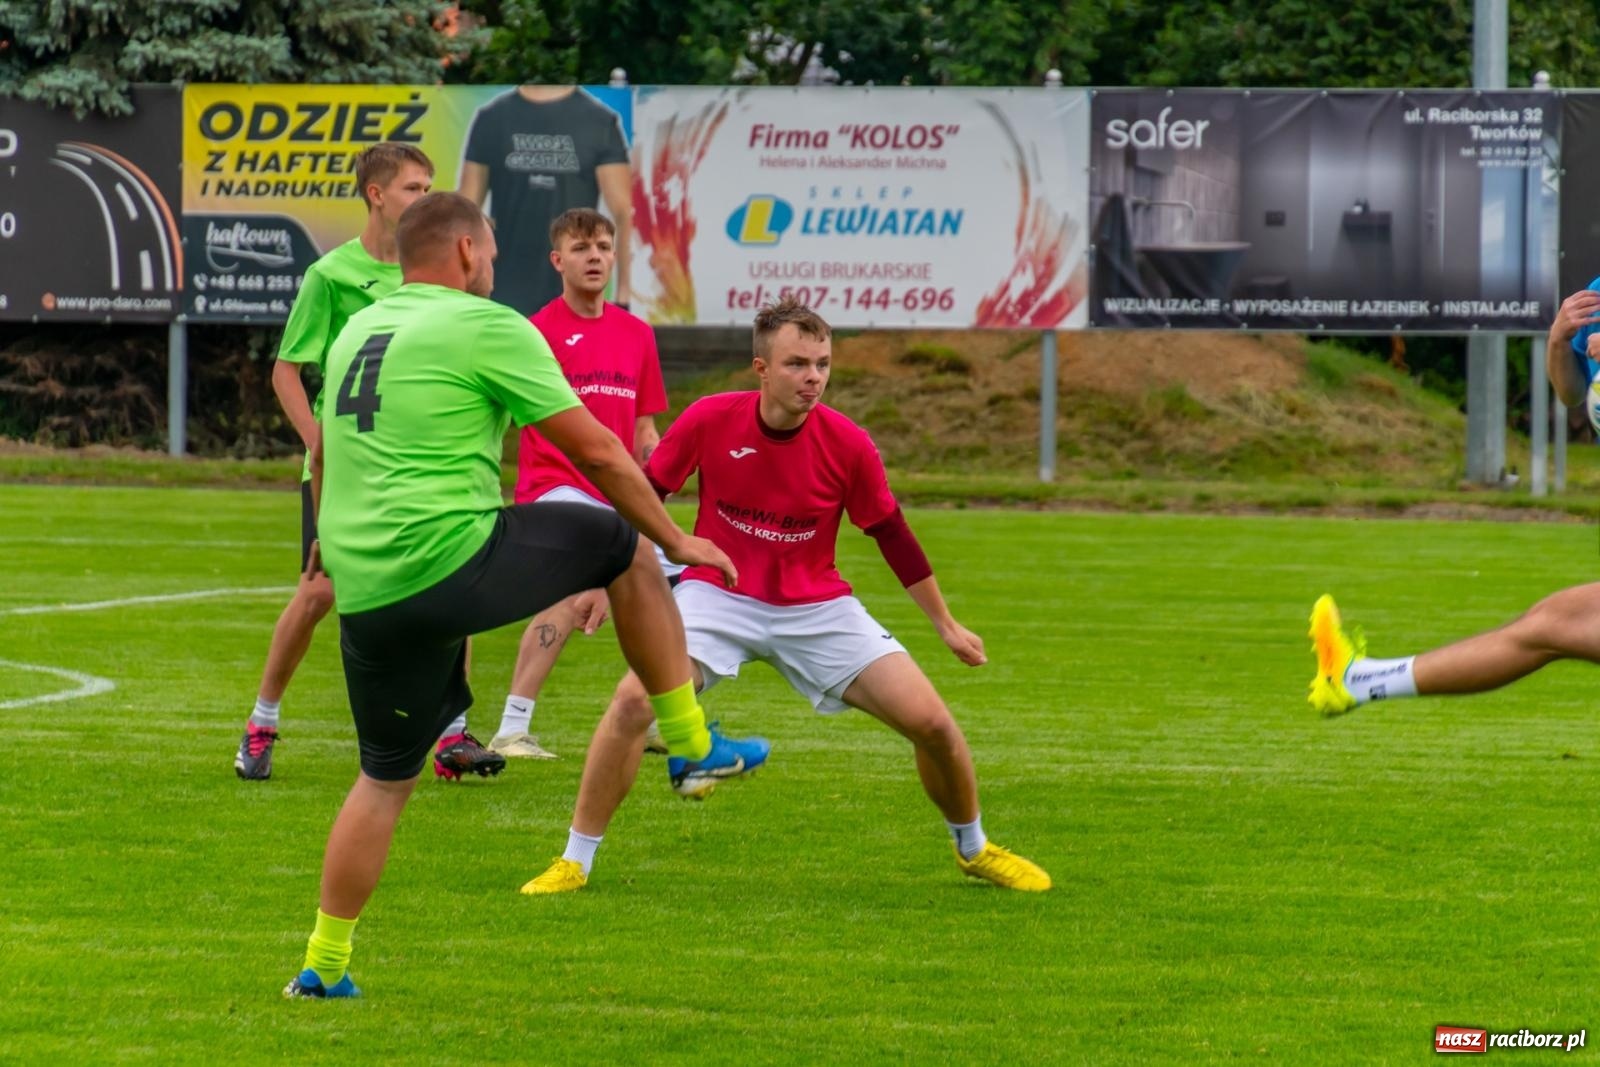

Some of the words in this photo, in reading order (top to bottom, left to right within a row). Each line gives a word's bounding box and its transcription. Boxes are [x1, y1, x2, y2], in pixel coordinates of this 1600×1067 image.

[199, 93, 429, 142] ODZIEŻ
[1404, 109, 1424, 124] ul.
[1428, 108, 1519, 124] Raciborska
[1522, 108, 1543, 123] 32
[749, 124, 829, 149] Firma
[1106, 106, 1210, 149] safer
[1470, 125, 1543, 141] Tworków
[204, 152, 227, 173] Z
[759, 156, 806, 169] Helena
[818, 156, 893, 170] Aleksander
[896, 156, 946, 170] Michna
[201, 181, 211, 196] I
[800, 205, 964, 236] LEWIATAN
[749, 262, 816, 279] USŁUGI
[820, 262, 932, 280] BRUKARSKIE
[56, 295, 172, 311] www.pro-daro.com
[1104, 298, 1220, 314] WIZUALIZACJE
[1233, 296, 1348, 317] WYPOSAŻENIE
[1351, 300, 1430, 318] ŁAZIENEK
[1443, 300, 1540, 317] INSTALACJE
[335, 332, 396, 434] 4
[754, 526, 817, 543] KRZYSZTOF
